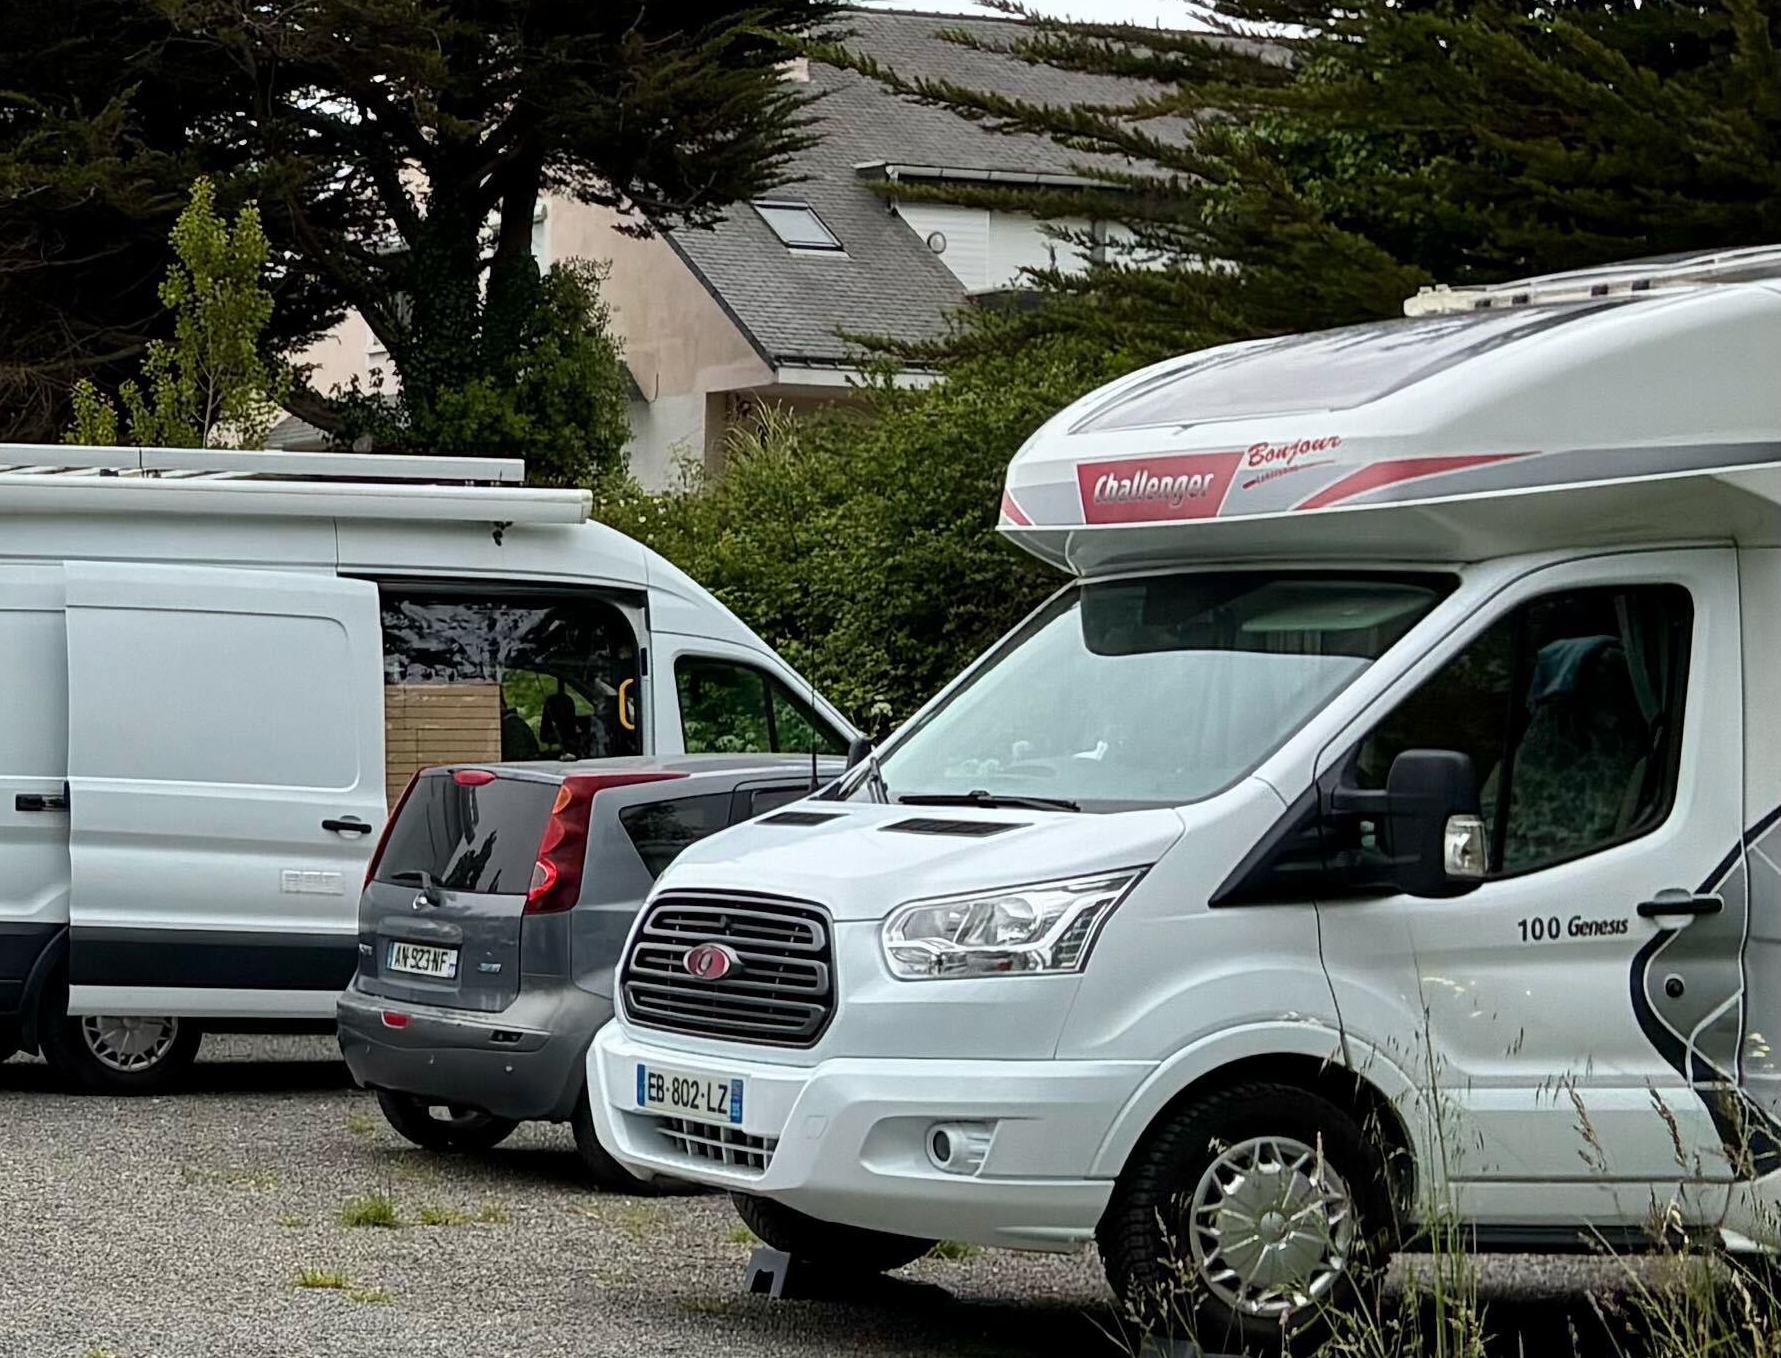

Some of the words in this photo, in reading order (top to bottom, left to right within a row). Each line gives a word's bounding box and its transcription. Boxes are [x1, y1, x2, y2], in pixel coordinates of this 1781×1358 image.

[1247, 434, 1342, 468] Bonjour
[1093, 469, 1215, 509] Challenger
[1518, 915, 1561, 942] 100
[1567, 914, 1629, 937] Genesis
